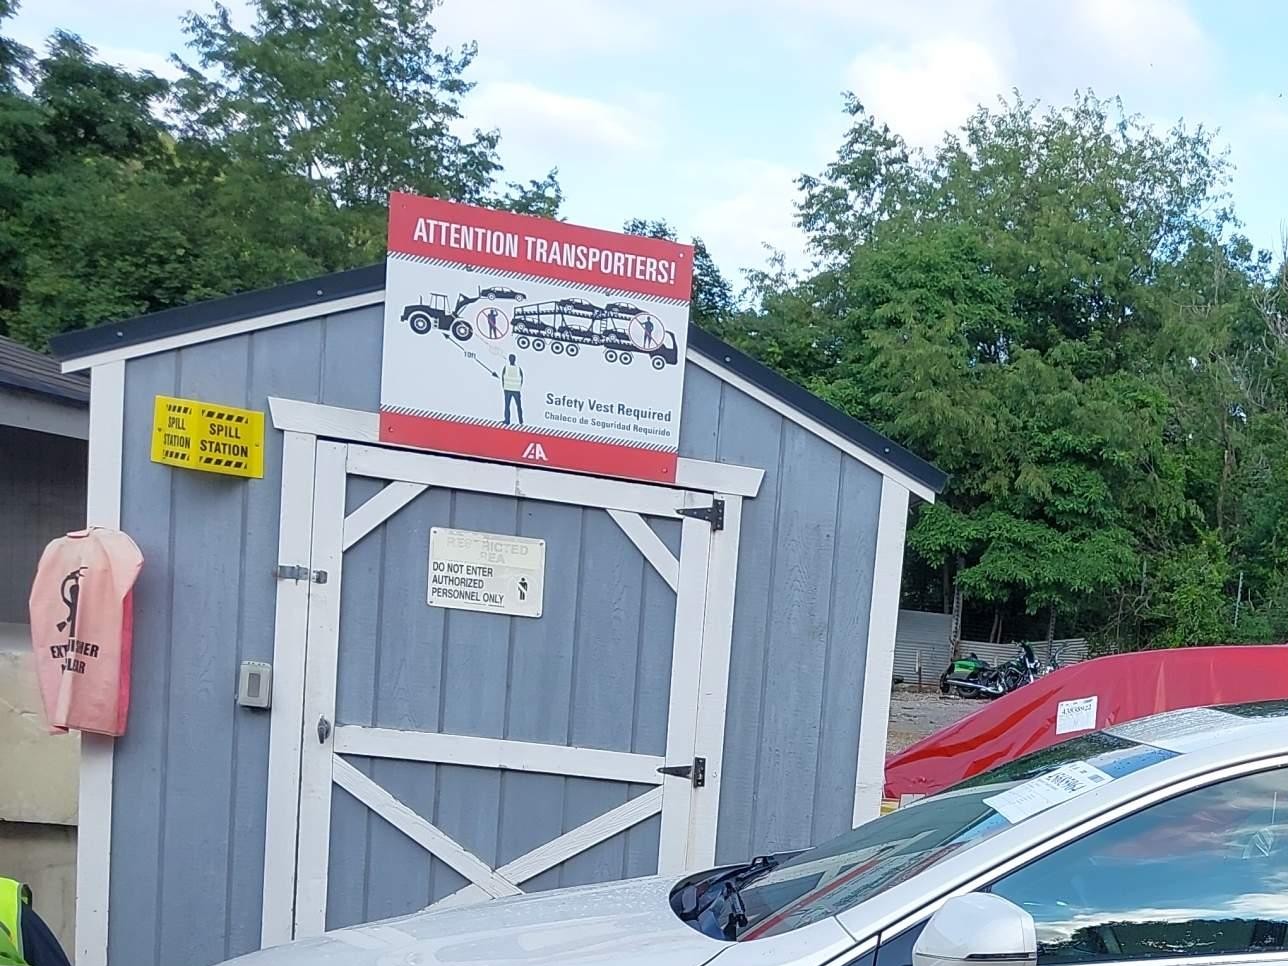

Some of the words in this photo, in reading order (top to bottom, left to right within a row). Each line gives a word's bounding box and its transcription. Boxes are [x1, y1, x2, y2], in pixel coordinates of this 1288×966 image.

[413, 217, 519, 258] ATTENTION
[524, 235, 677, 285] TRANSPORTERS!
[545, 392, 585, 412] Safety
[588, 398, 614, 414] Vest
[617, 403, 672, 422] Required
[167, 416, 186, 431] SPILL
[544, 411, 577, 424] Chaleco
[579, 416, 589, 425] de
[590, 418, 631, 431] Seguridad
[209, 422, 241, 440] SPILL
[163, 433, 191, 449] STATION
[199, 439, 249, 458] STATION
[432, 561, 445, 572] DO
[446, 563, 465, 575] NOT
[466, 565, 494, 578] ENTER
[431, 574, 485, 590] AUTHORIZED
[431, 587, 481, 603] PERSONNEL
[482, 592, 505, 605] ONLY
